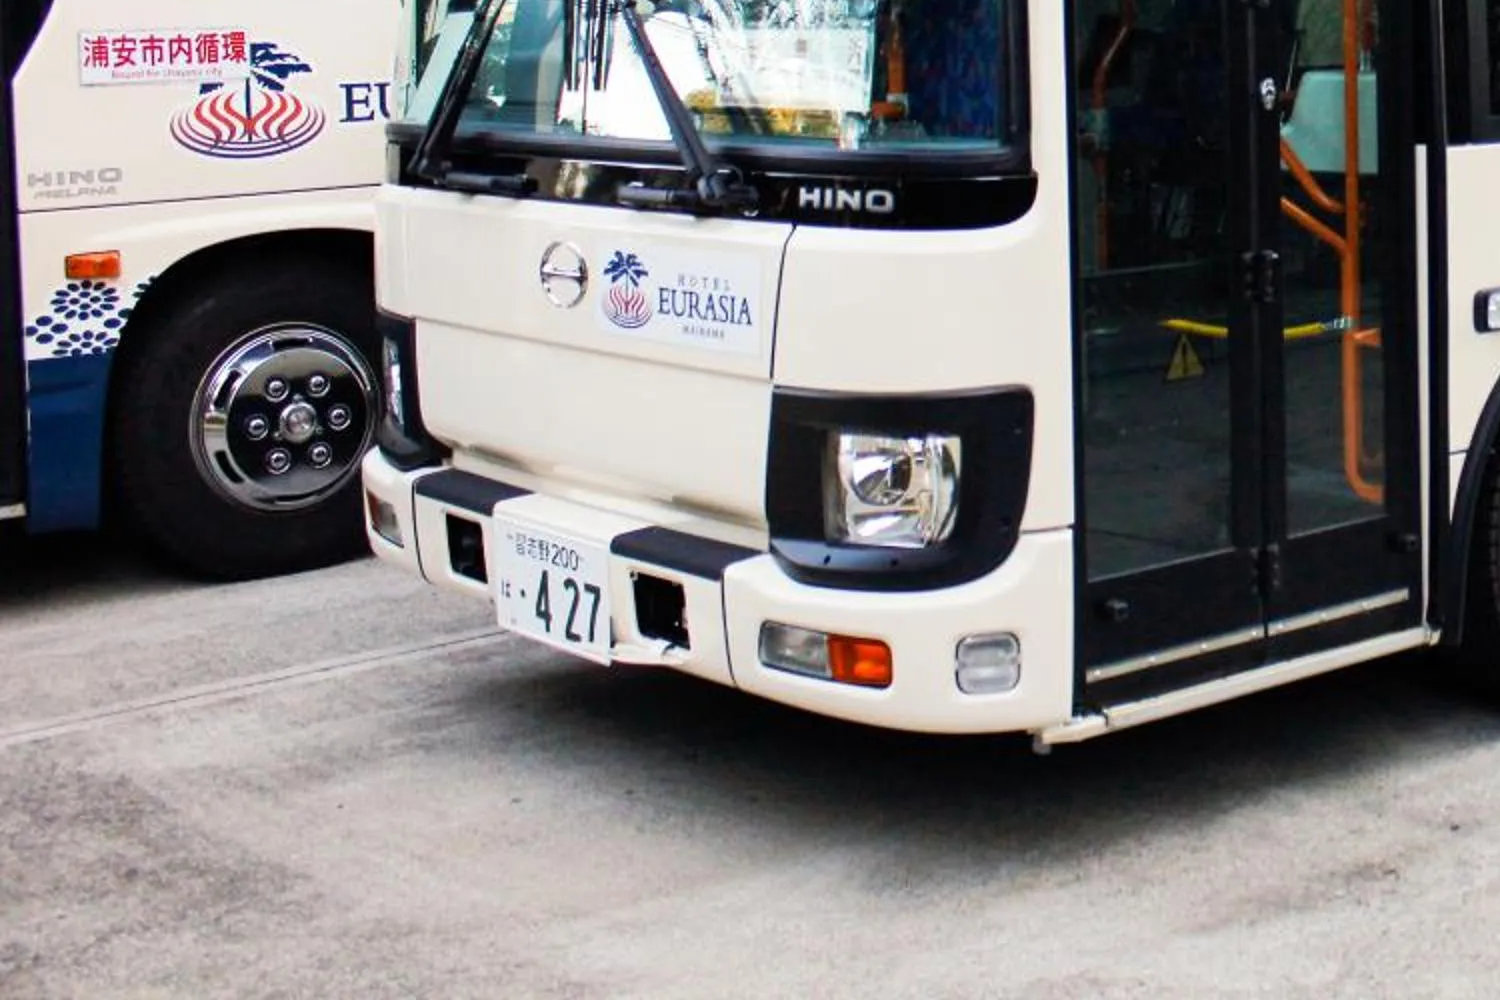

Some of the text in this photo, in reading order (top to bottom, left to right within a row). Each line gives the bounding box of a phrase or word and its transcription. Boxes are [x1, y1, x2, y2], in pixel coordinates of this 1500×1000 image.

[83, 31, 248, 68] 浦安市内循環
[27, 167, 123, 189] HINO
[799, 187, 895, 213] HINO
[677, 273, 731, 292] HOTEL
[657, 287, 753, 326] EURASIA
